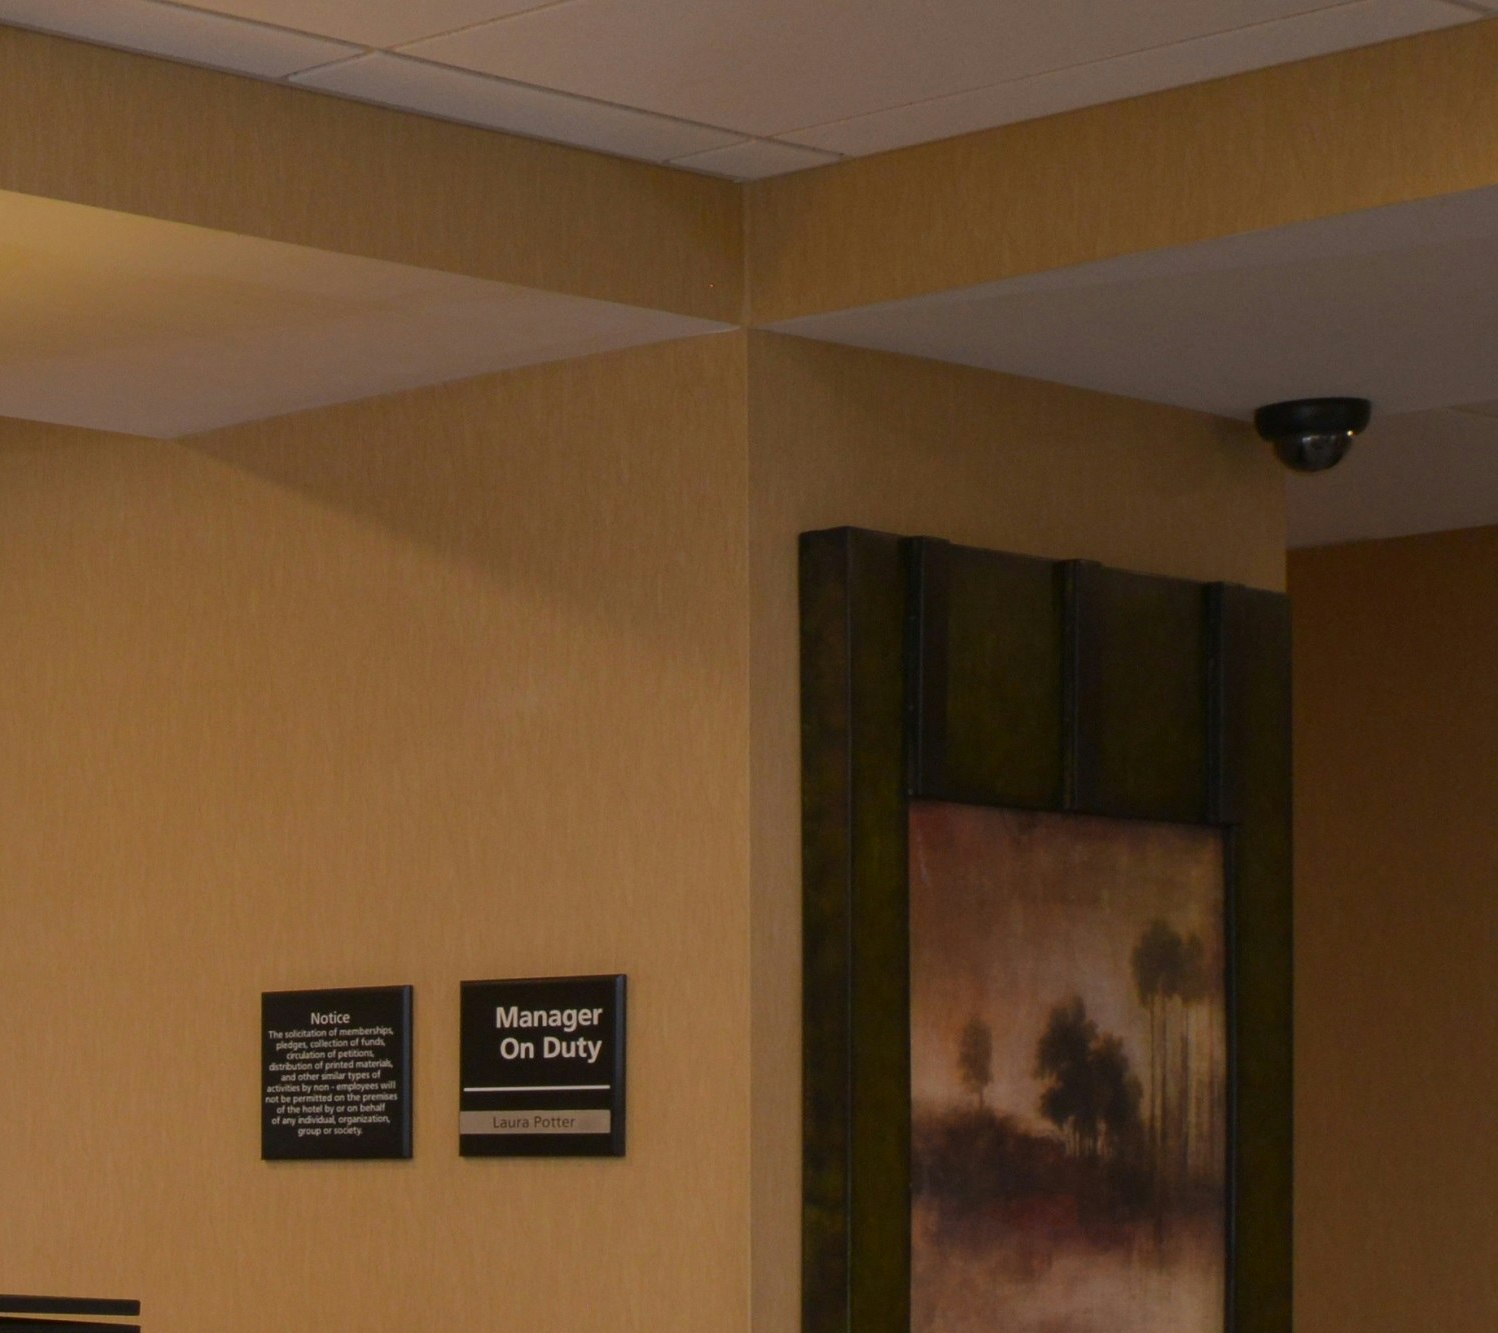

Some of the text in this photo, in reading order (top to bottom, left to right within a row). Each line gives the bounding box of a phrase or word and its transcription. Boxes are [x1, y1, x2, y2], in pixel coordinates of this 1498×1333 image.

[310, 1011, 351, 1025] Notice
[496, 1006, 603, 1032] Manager
[268, 1030, 283, 1039] The
[284, 1028, 327, 1039] solicitation
[328, 1027, 339, 1037] of
[309, 1039, 348, 1048] collection
[350, 1038, 359, 1047] of
[286, 1050, 325, 1060] circulation
[327, 1049, 336, 1058] of
[500, 1036, 603, 1063] On Duty
[268, 1061, 313, 1071] distribution
[314, 1060, 324, 1070] of
[325, 1060, 354, 1072] printed
[281, 1069, 381, 1081] and other similar types of
[266, 1084, 301, 1093] activities
[301, 1083, 312, 1093] by
[336, 1082, 379, 1093] employees
[380, 1081, 396, 1089] will
[265, 1095, 280, 1103] not
[281, 1094, 291, 1103] be
[292, 1093, 333, 1104] permitted
[347, 1092, 361, 1101] the
[362, 1092, 398, 1103] premises
[276, 1105, 285, 1114] of
[287, 1105, 301, 1114] the
[302, 1104, 323, 1113] hotel
[324, 1104, 335, 1114] by
[359, 1103, 386, 1112] behalf
[271, 1116, 281, 1125] of
[282, 1117, 296, 1126] any
[493, 1115, 576, 1129] Laura Potter
[298, 1127, 322, 1137] group
